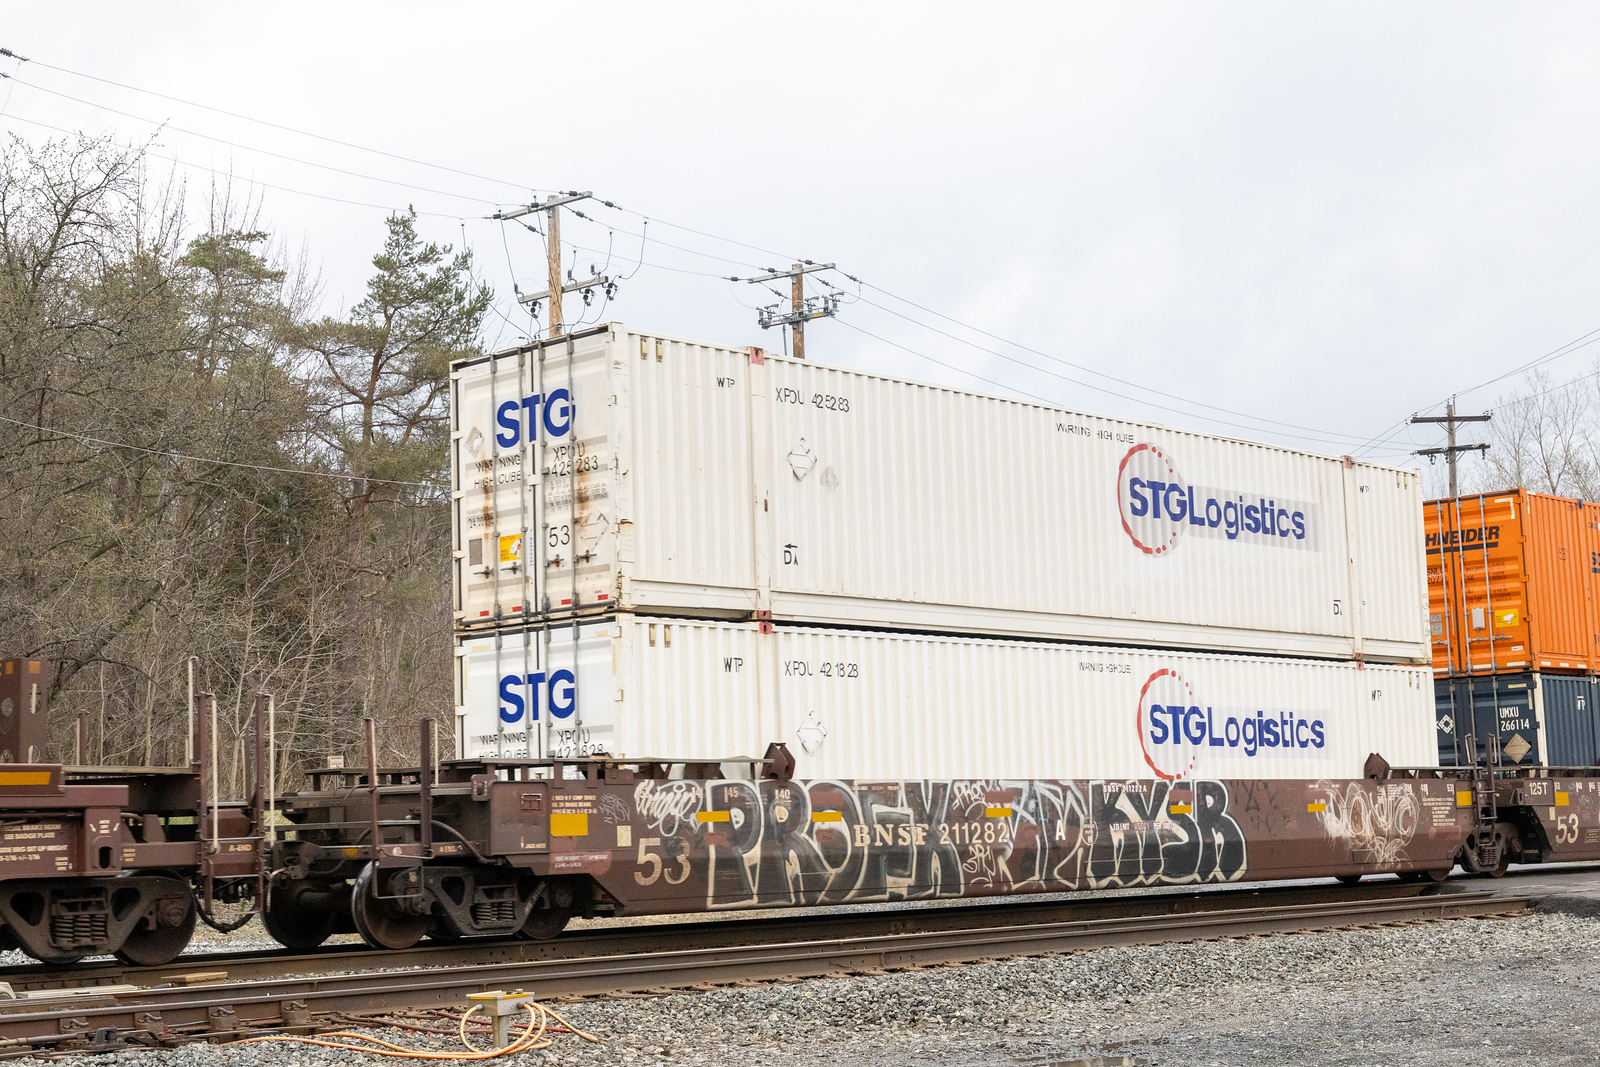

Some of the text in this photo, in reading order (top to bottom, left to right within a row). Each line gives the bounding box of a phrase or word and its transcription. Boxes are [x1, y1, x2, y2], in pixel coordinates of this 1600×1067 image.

[496, 388, 576, 448] STG
[548, 524, 571, 548] 53
[499, 669, 575, 724] STG
[1499, 707, 1519, 718] UMXU
[1501, 719, 1530, 732] 266114
[727, 788, 738, 798] 45
[853, 819, 1067, 846] BNSF 211282 A
[1555, 813, 1579, 844] 53
[633, 837, 691, 886] 53
